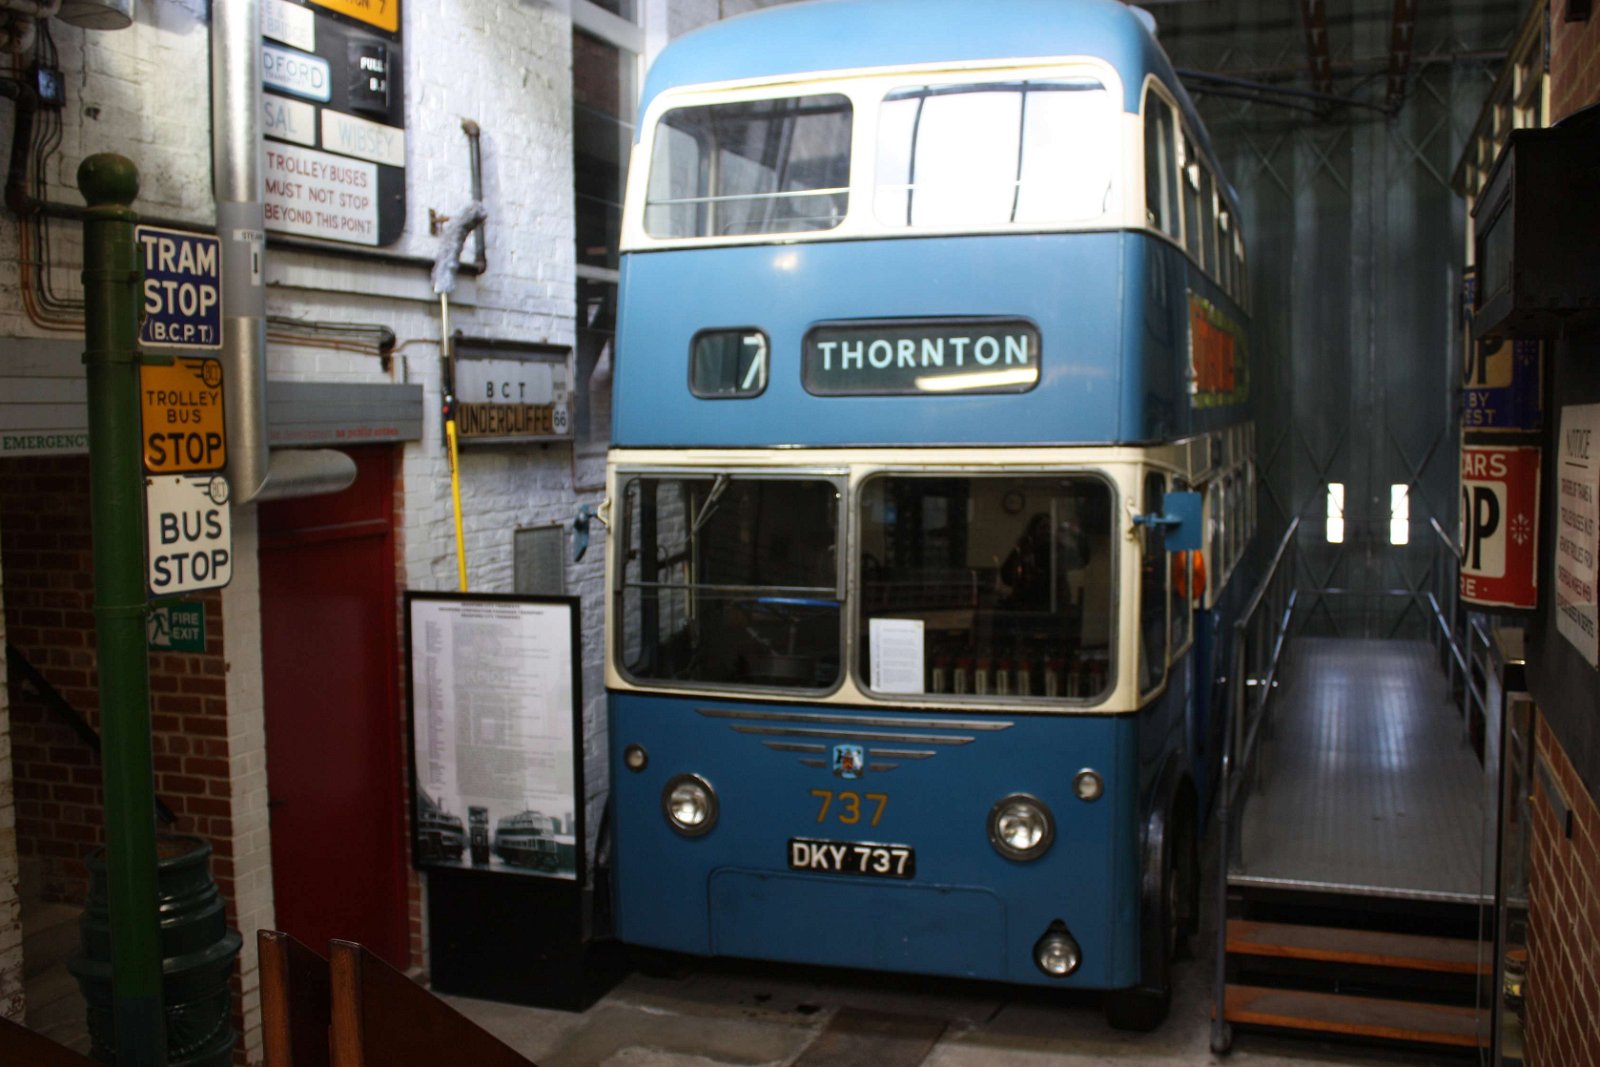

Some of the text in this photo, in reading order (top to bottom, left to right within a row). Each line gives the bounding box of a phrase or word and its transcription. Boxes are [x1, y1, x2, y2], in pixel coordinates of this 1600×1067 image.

[338, 119, 394, 158] WIBSEY
[265, 178, 369, 210] MUST NOT STOP
[264, 203, 373, 235] BEYOND THIS POINT
[141, 234, 216, 278] TRAM
[144, 278, 217, 318] STOP
[743, 334, 764, 390] 7
[818, 335, 1028, 371] THORNTON
[146, 389, 219, 406] TROLLEY
[1468, 392, 1490, 408] BY
[167, 408, 202, 424] BUS
[460, 404, 550, 435] UNDERCLIFFE
[553, 410, 567, 427] 66
[148, 432, 222, 466] STOP
[160, 509, 223, 545] BUS
[153, 549, 229, 587] STOP
[171, 611, 199, 625] FIRE
[172, 626, 200, 640] EXIT
[810, 788, 889, 828] 737
[792, 842, 910, 875] DKY 737
